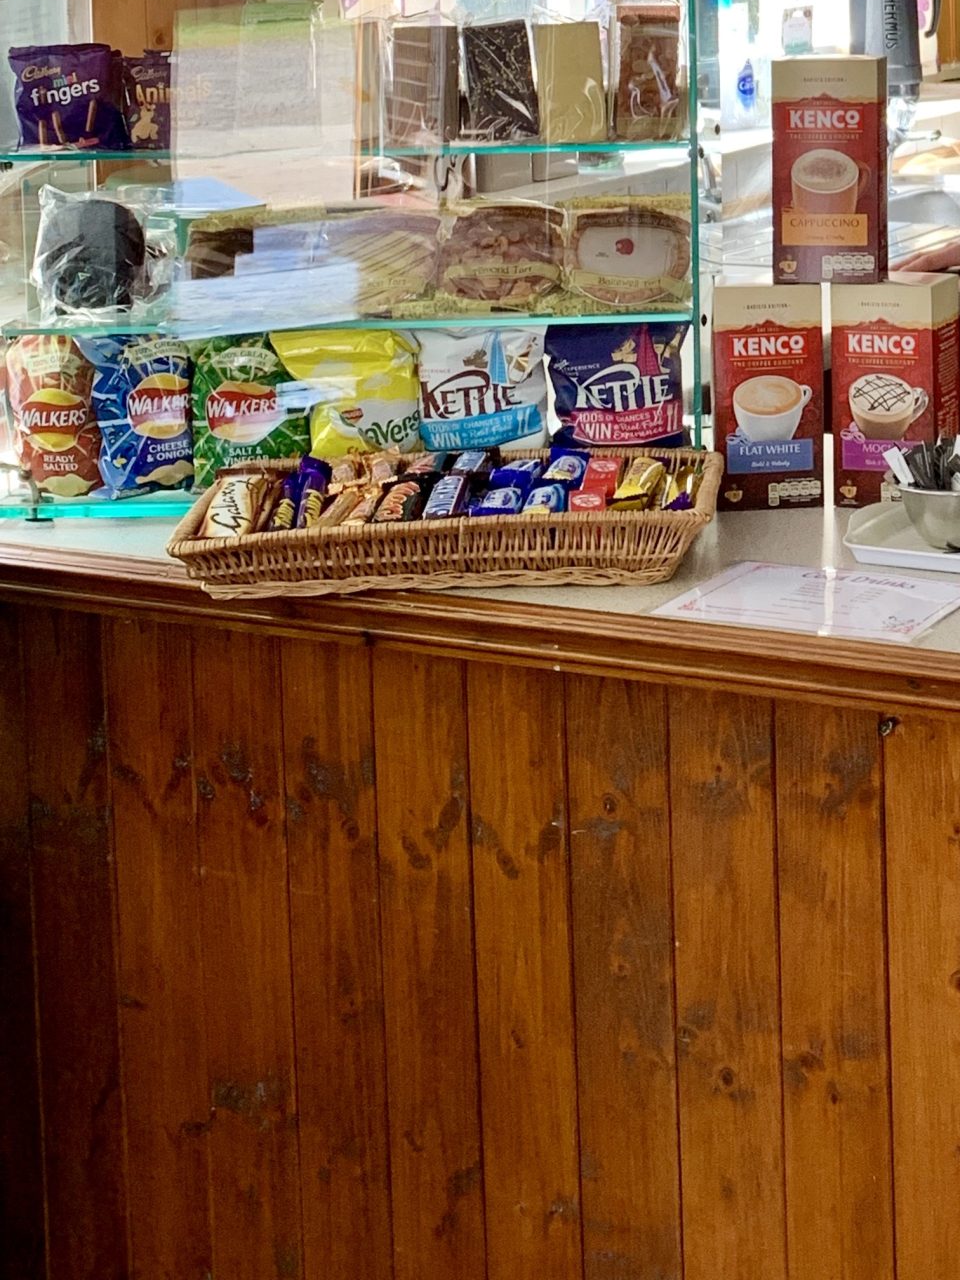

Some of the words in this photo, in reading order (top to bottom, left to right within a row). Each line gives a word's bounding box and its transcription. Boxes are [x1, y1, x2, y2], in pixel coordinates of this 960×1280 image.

[21, 65, 61, 83] Cadbury
[30, 78, 101, 107] fingers
[135, 74, 213, 105] Animals
[789, 109, 860, 129] KENCO
[790, 218, 860, 228] CAPPUCCINO
[733, 335, 804, 357] KENCO
[848, 334, 915, 355] KENCO
[239, 349, 268, 360] GREAT
[420, 369, 523, 420] KETTLE
[570, 363, 674, 413] KETTLE
[128, 393, 190, 416] WALKER
[207, 397, 278, 419] WALKERS
[21, 407, 87, 428] WALKERS
[431, 431, 462, 449] WIN
[582, 422, 612, 440] WIN
[146, 452, 154, 462] &
[155, 447, 192, 461] ONION
[149, 439, 189, 453] CHEESE
[229, 446, 252, 456] SALT
[255, 446, 263, 455] &
[739, 444, 764, 456] FLAT
[766, 443, 801, 455] WHITE
[43, 453, 75, 464] READY
[43, 462, 78, 471] SALTED
[210, 477, 258, 534] Galaxy
